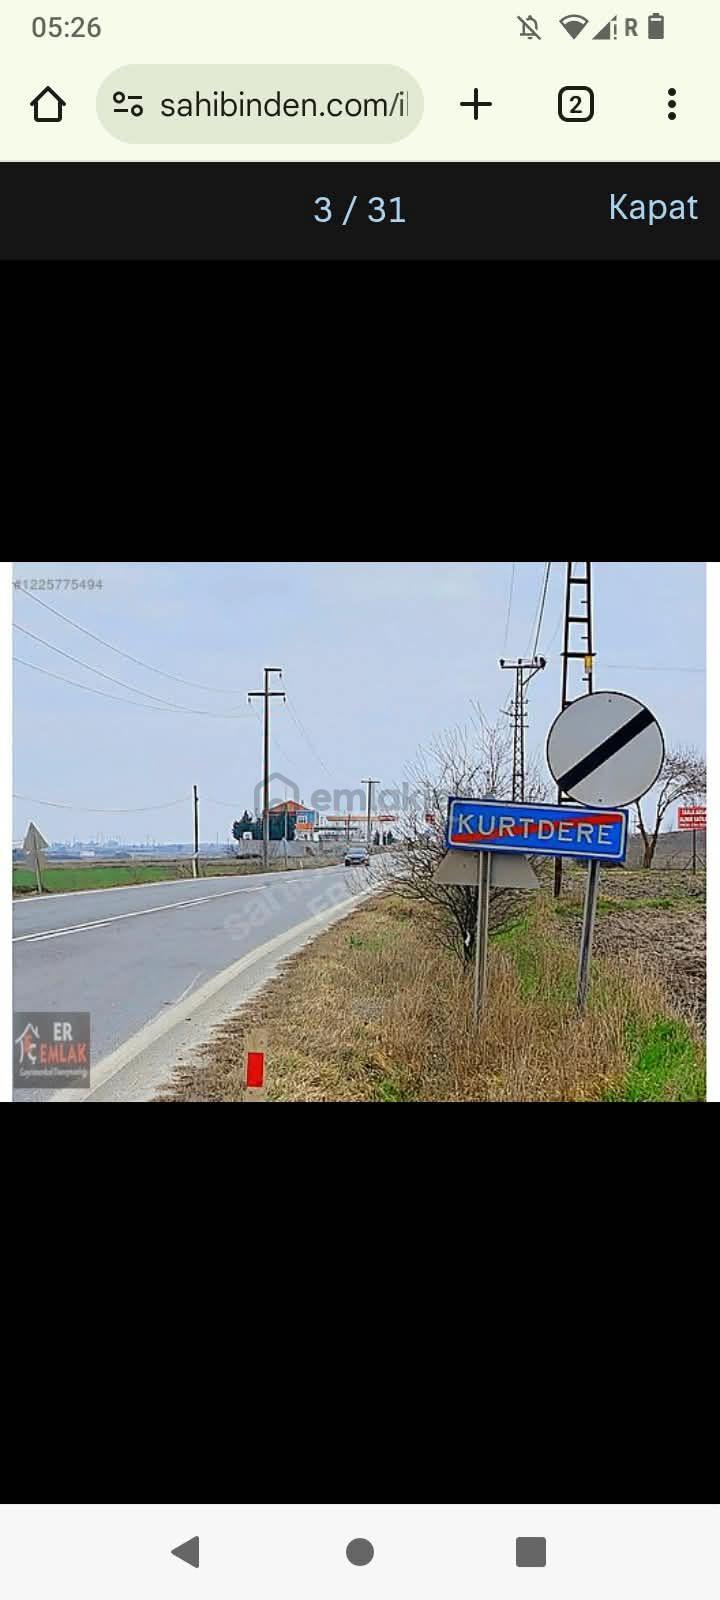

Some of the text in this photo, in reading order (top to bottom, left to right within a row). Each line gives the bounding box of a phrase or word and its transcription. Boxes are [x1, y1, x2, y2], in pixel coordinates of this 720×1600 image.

[32, 16, 102, 38] 05:26
[624, 17, 639, 37] R
[160, 90, 409, 118] sahibinden.com/i
[568, 95, 583, 114] 2
[313, 195, 406, 226] 3 / 31
[609, 193, 699, 226] Kapat
[458, 813, 614, 846] KURTDERE
